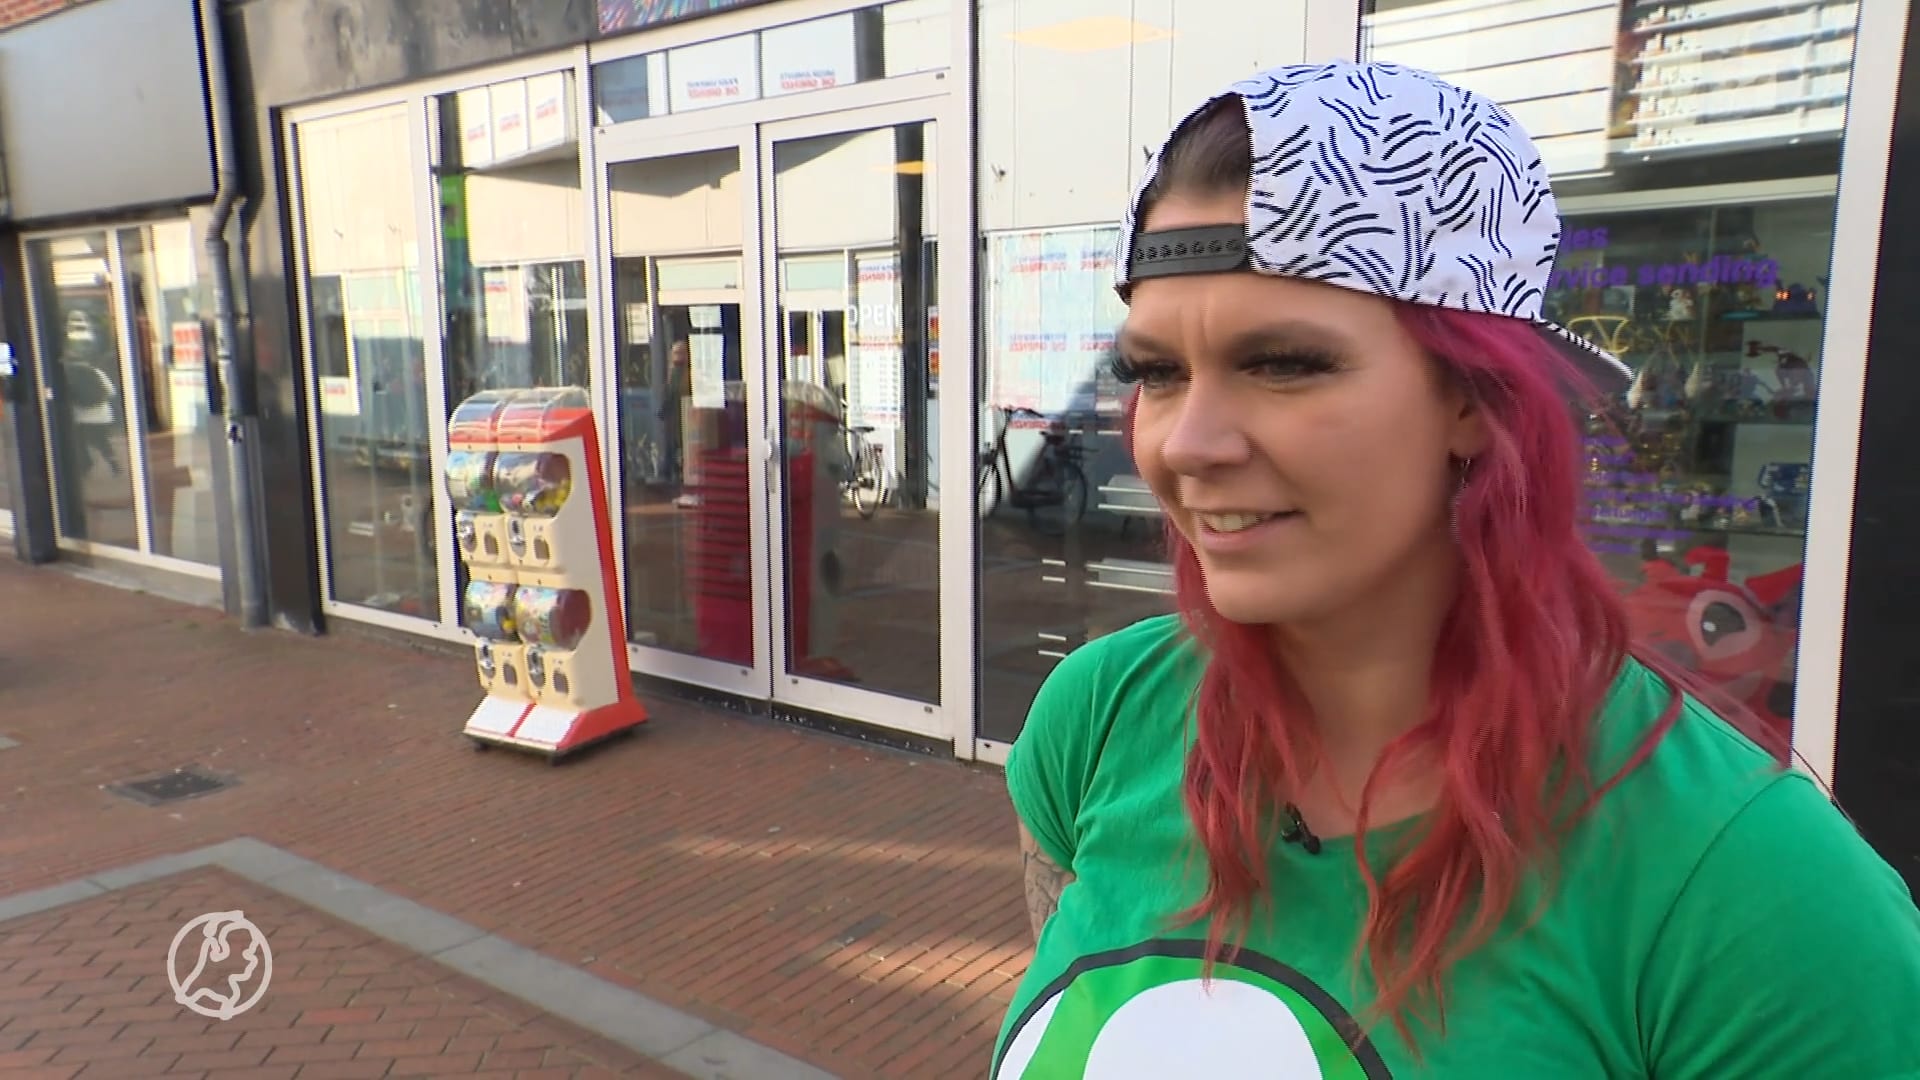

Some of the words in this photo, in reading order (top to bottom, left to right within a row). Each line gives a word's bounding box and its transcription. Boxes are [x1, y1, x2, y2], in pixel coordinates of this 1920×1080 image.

[1550, 261, 1628, 289] rvice
[1637, 254, 1779, 288] sending
[848, 304, 900, 328] OPEN
